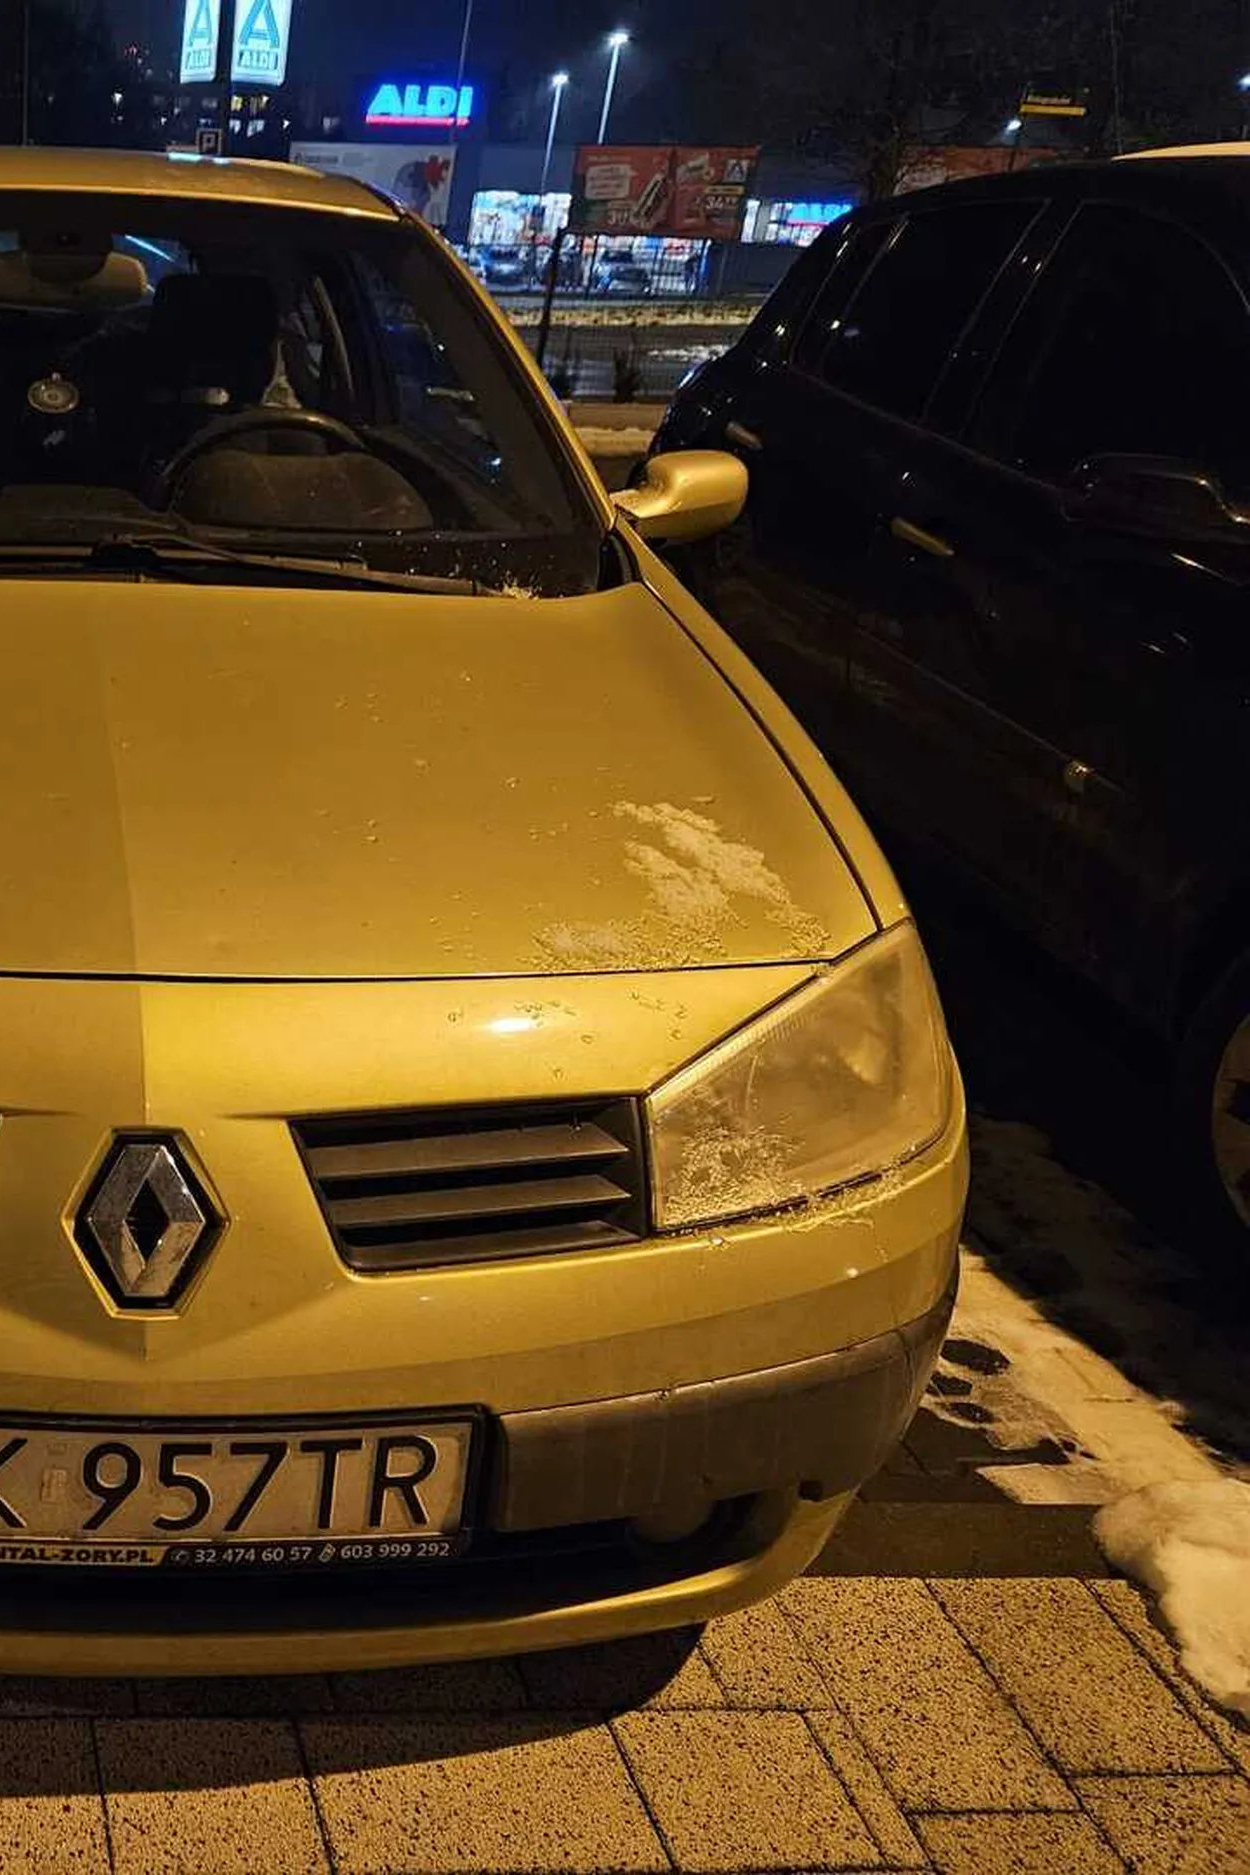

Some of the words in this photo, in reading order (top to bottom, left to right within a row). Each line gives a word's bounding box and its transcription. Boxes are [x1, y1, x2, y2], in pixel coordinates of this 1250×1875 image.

[237, 49, 279, 70] ALDI
[367, 83, 474, 117] ALDI
[83, 1435, 440, 1531] 957TR
[195, 1550, 216, 1563] 32
[222, 1548, 255, 1563] 474
[261, 1548, 284, 1562] 60
[290, 1546, 312, 1561] 57
[341, 1545, 373, 1560] 603
[379, 1543, 411, 1558] 999
[416, 1542, 450, 1557] 292
